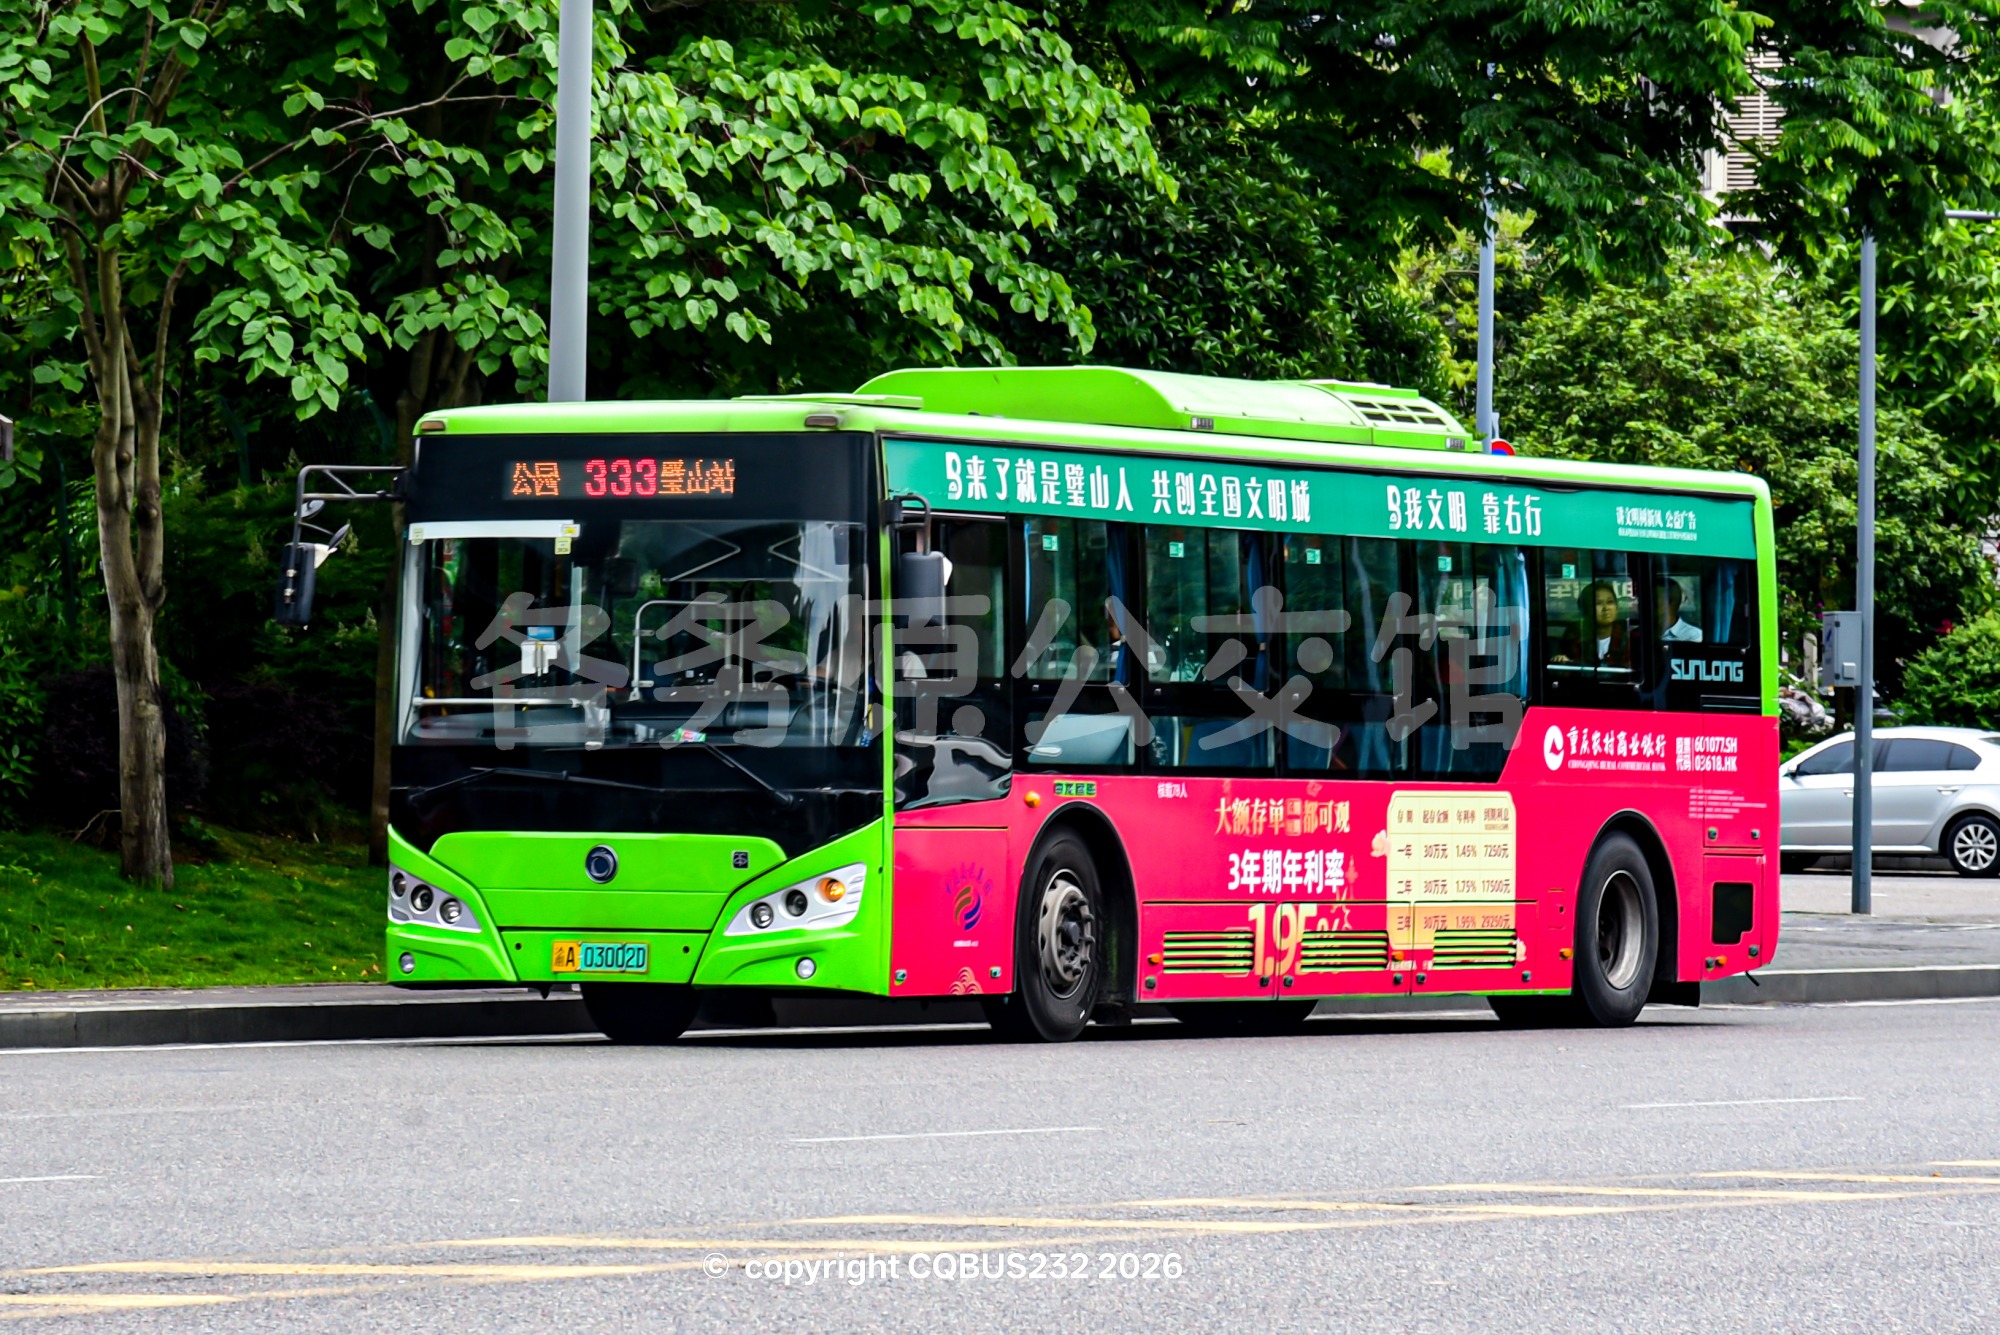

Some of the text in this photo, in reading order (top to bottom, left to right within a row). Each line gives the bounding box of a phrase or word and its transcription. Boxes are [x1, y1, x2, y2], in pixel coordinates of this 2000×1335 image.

[584, 458, 658, 497] 333
[1151, 468, 1312, 523] 共创全国文明城
[1481, 492, 1543, 537] 靠右行
[1670, 657, 1745, 683] SUNLONG
[1566, 725, 1668, 759] 重庆农村商业银行
[1694, 735, 1738, 754] 601077.SH
[1694, 754, 1738, 772] 03618.HK
[1227, 848, 1346, 895] 3年期年利率
